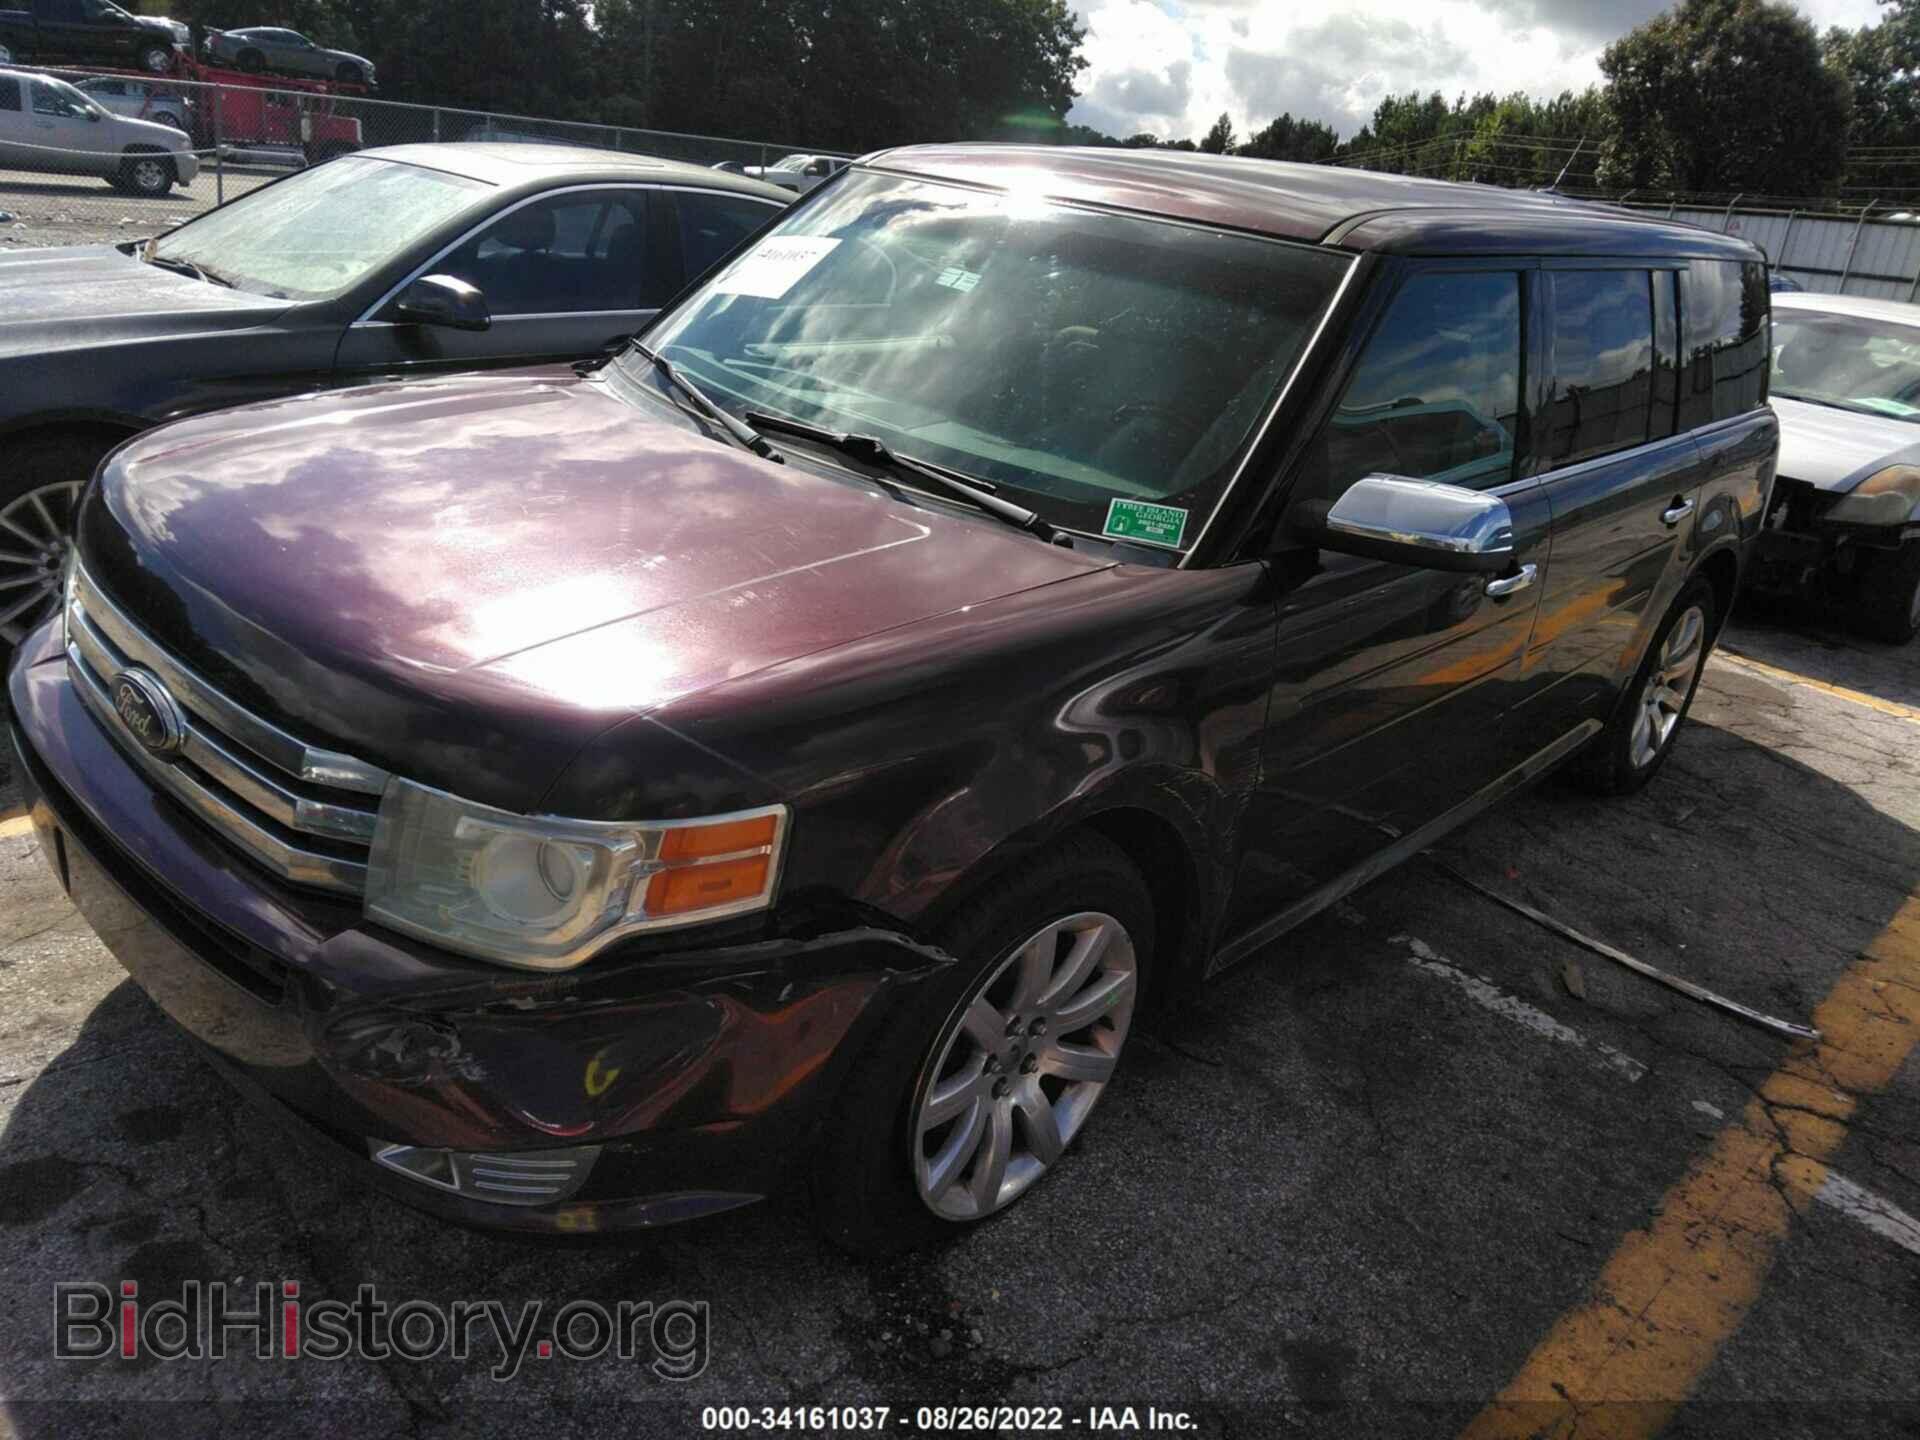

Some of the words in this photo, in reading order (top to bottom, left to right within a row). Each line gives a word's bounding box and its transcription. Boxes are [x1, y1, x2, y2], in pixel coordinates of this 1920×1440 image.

[1135, 511, 1181, 525] GEORGIA
[1147, 507, 1183, 519] ISLAND
[115, 683, 152, 737] Ford
